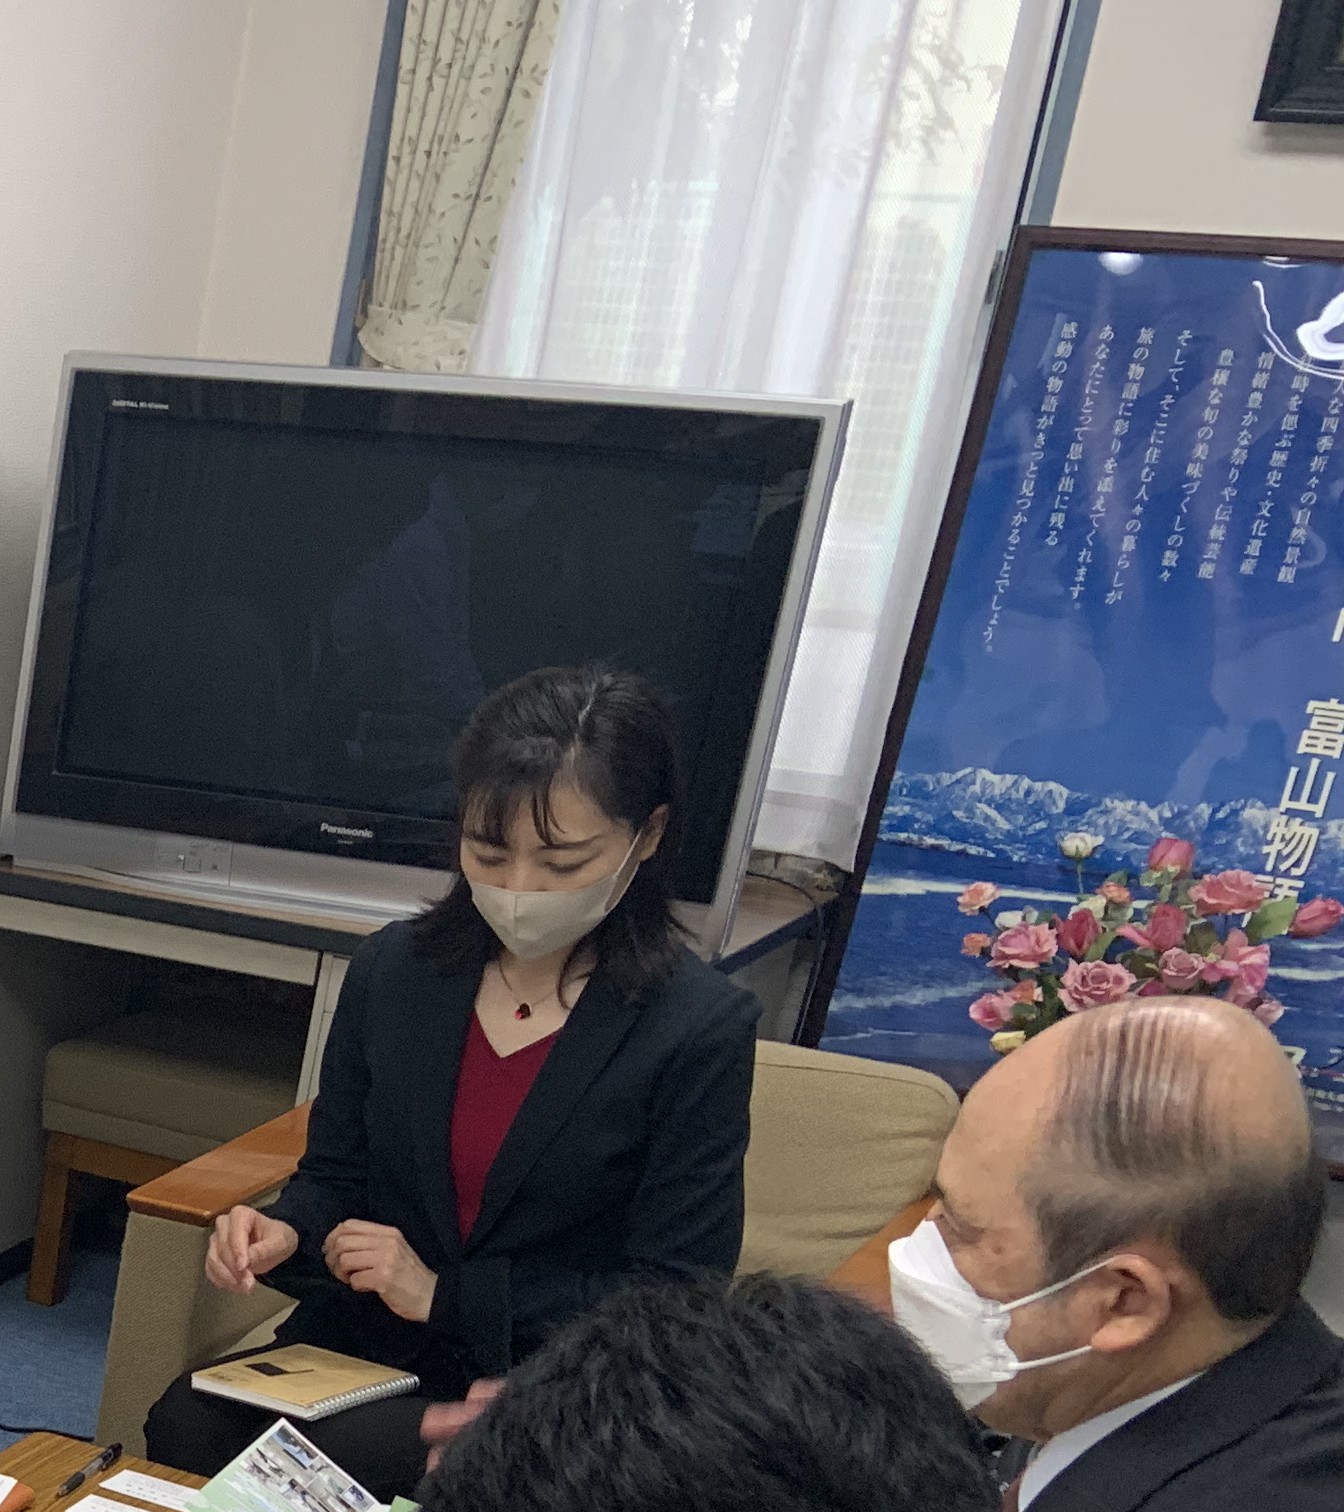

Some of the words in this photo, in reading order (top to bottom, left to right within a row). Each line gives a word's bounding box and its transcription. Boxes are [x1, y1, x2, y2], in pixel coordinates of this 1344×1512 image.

[983, 321, 1079, 652] 感動の物語がきっと見つかることでしょう。
[1045, 324, 1115, 547] あなたにとって思い出に残る
[1069, 327, 1155, 610] 旅の物語に彩りを添えてくれます。
[1104, 329, 1193, 605] そして、そこに住む人々の暮らしが
[320, 822, 374, 838] Panasonic
